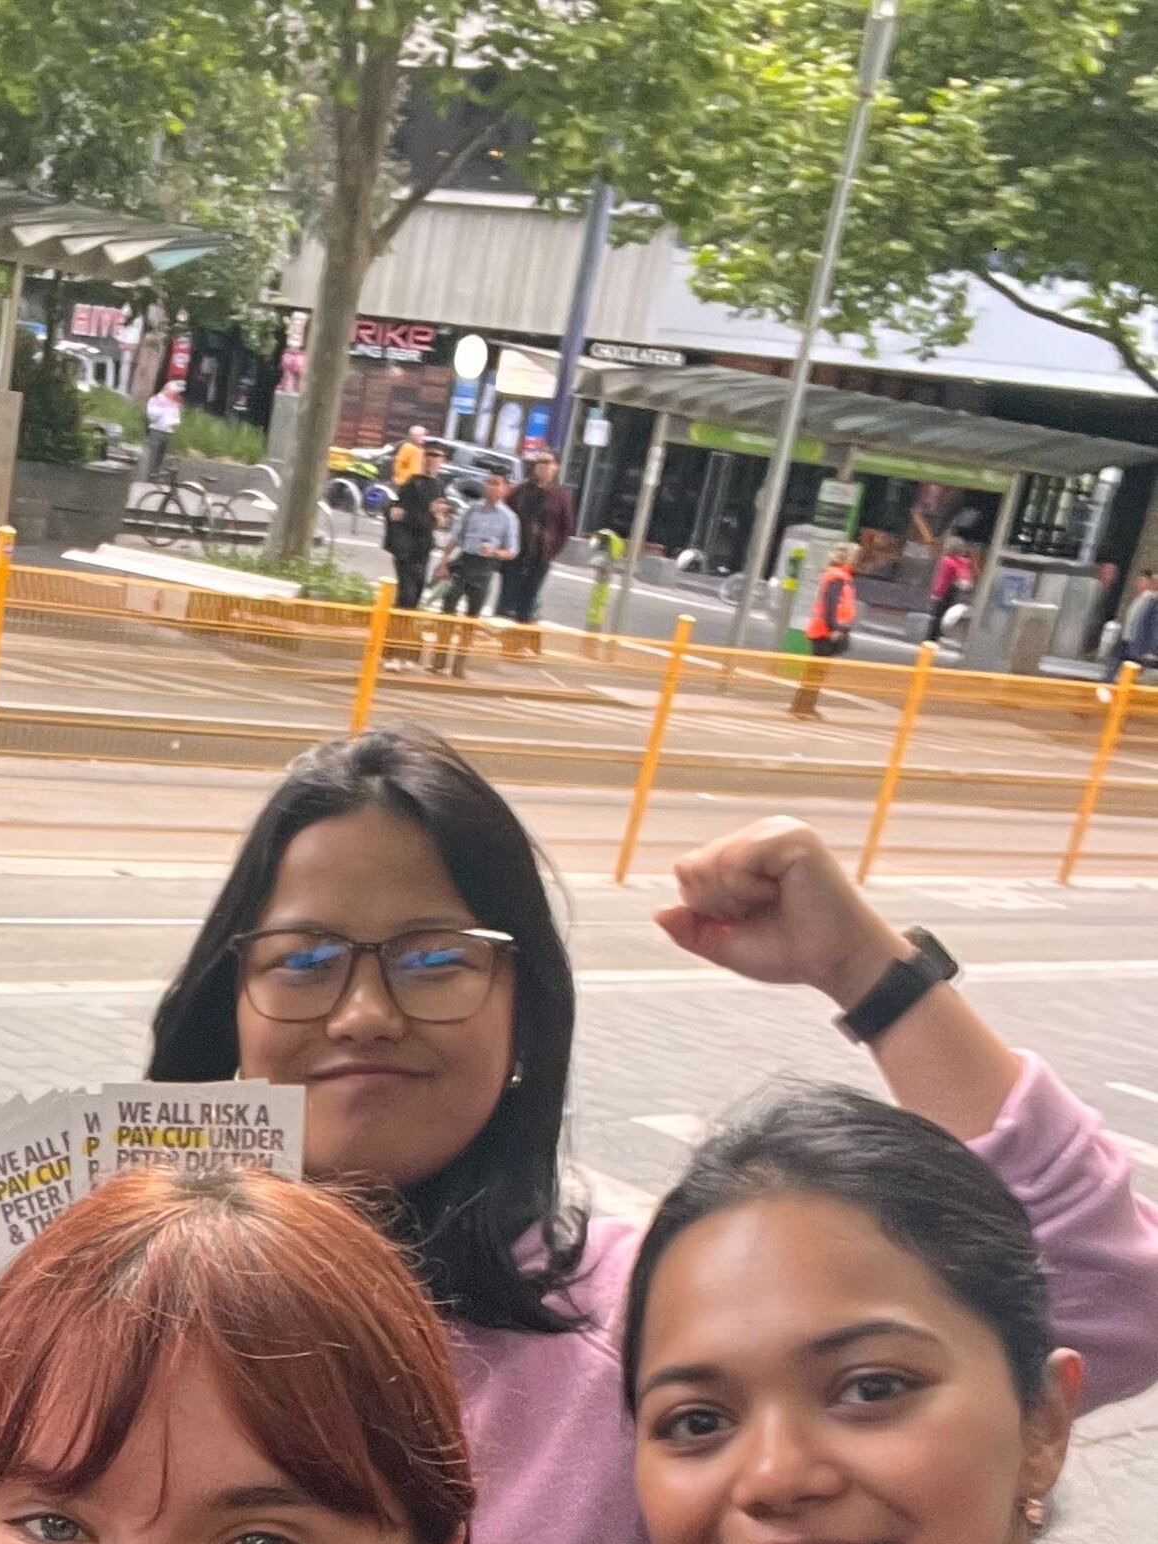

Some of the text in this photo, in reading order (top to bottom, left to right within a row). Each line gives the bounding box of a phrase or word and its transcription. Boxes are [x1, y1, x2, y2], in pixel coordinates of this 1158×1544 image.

[117, 1101, 152, 1123] WE
[156, 1102, 194, 1125] ALL
[200, 1102, 250, 1126] RISK
[254, 1104, 270, 1126] A
[24, 1137, 61, 1167] ALL
[117, 1126, 157, 1147] PAY
[162, 1127, 203, 1148] CUT
[209, 1128, 284, 1151] UNDER
[0, 1185, 64, 1224] PETER
[8, 1223, 26, 1246] &
[25, 1208, 62, 1237] TH
